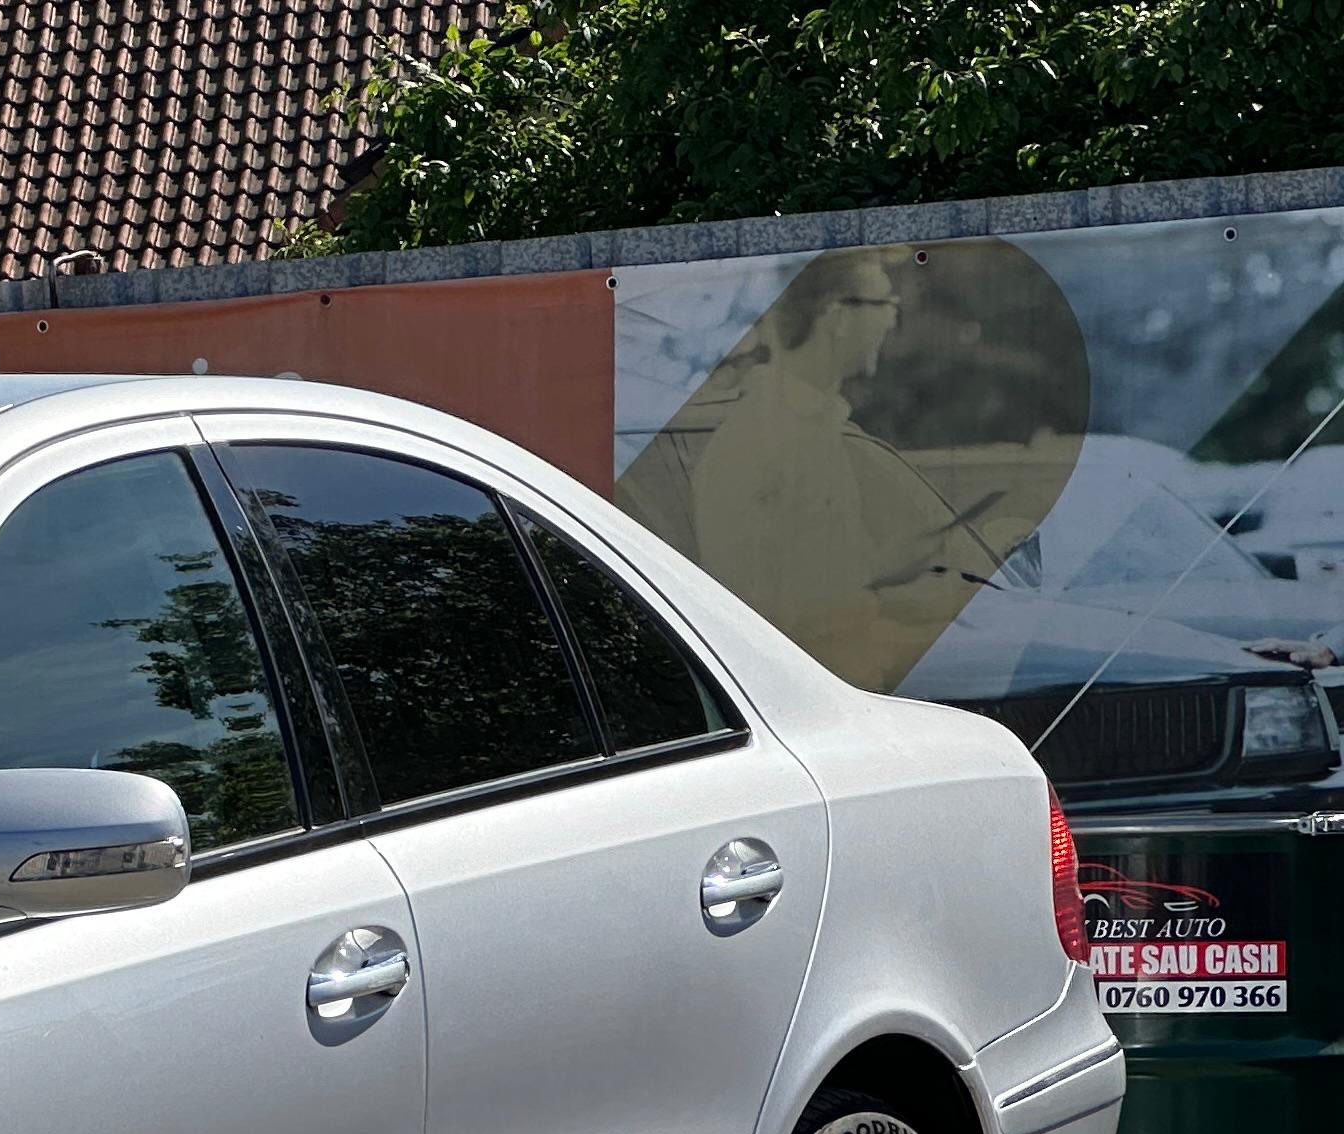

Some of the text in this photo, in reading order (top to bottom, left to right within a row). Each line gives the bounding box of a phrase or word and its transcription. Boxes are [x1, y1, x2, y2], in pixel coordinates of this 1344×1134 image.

[1093, 917, 1226, 938] BEST AUTO
[1082, 944, 1279, 976] ATE SAU CASH
[1105, 985, 1281, 1008] 0760 970 366
